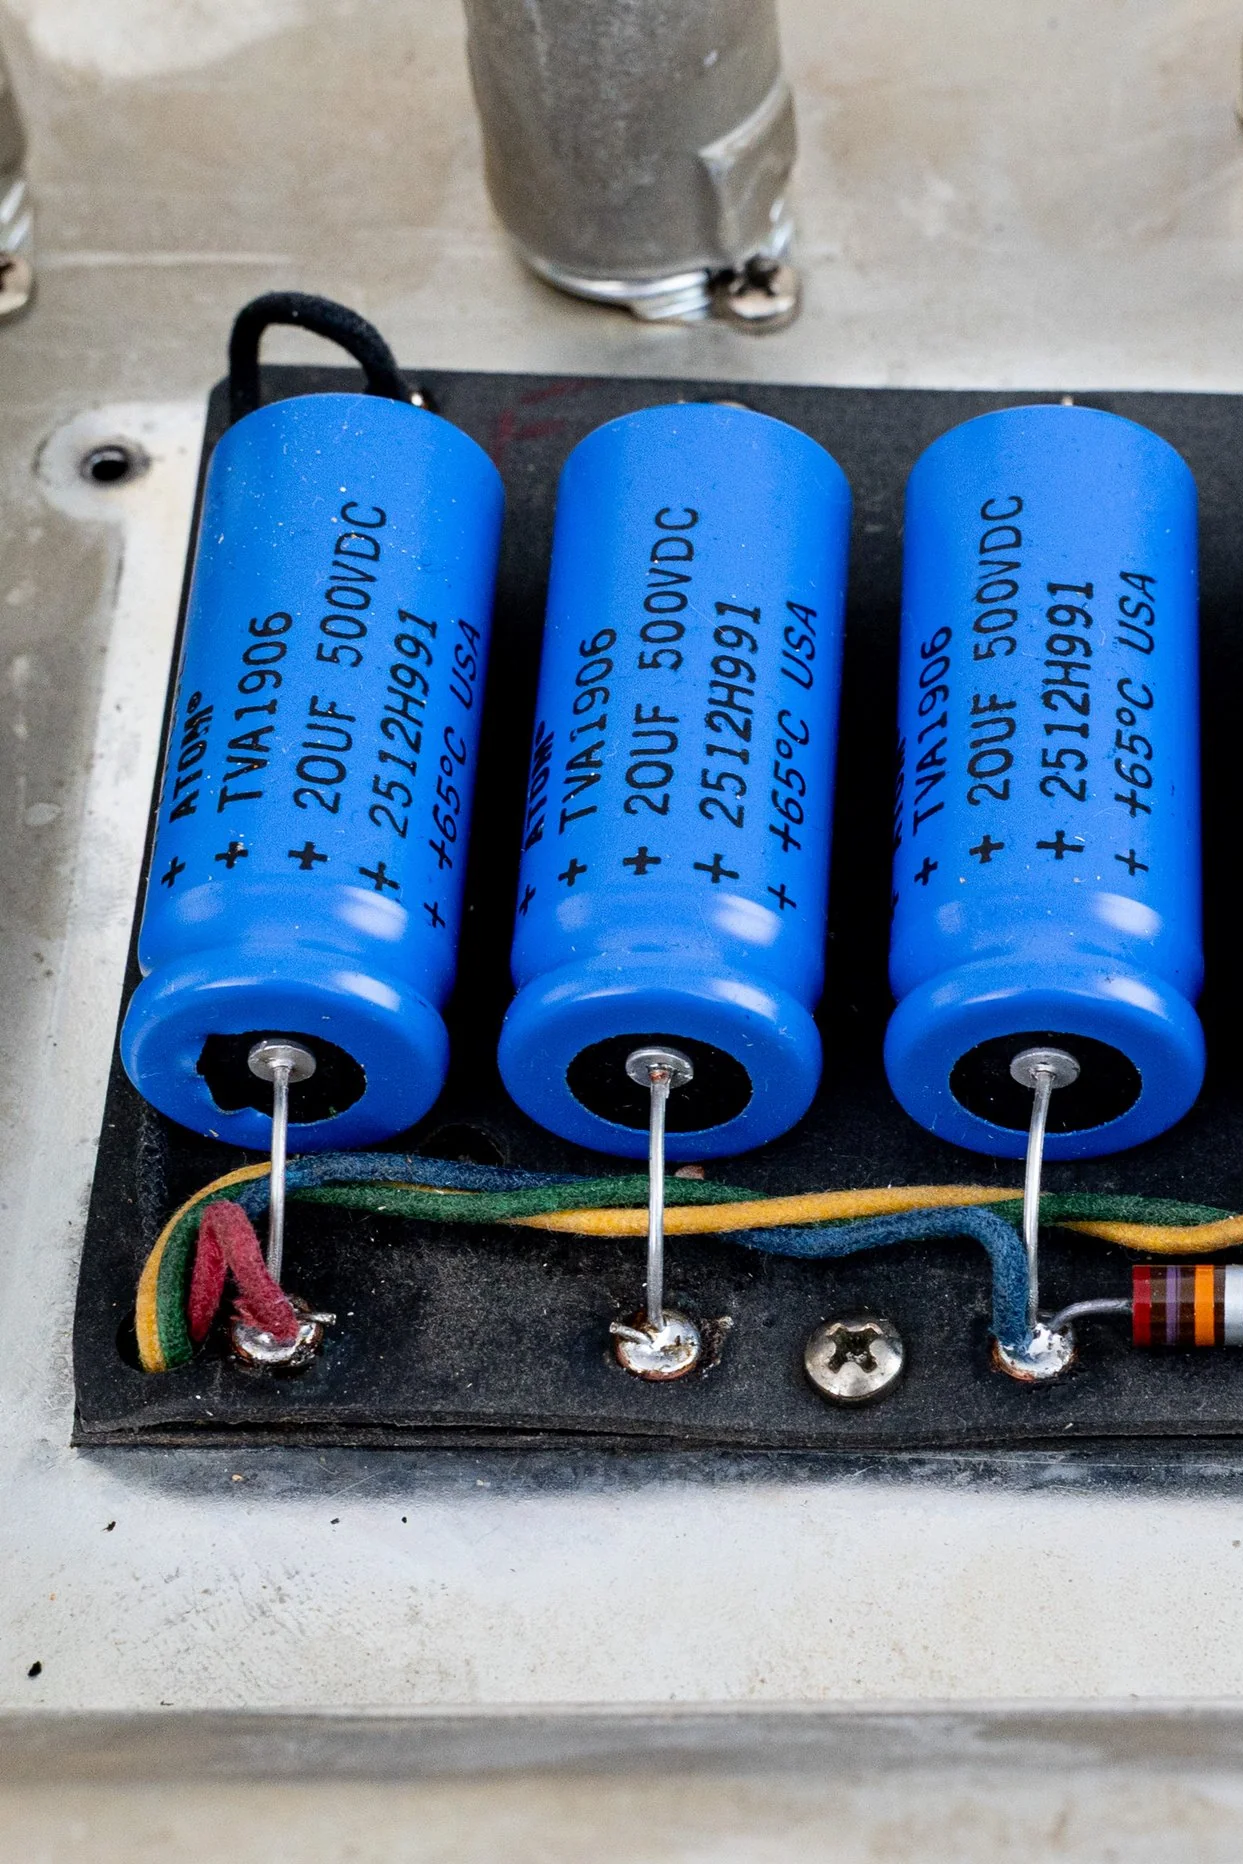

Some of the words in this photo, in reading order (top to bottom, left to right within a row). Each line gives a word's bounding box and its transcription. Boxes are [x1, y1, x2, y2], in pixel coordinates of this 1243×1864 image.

[317, 502, 387, 668] 500VDC
[638, 506, 699, 671] 500VDC
[781, 600, 818, 690] USA
[972, 495, 1024, 661] 500VDC
[1118, 570, 1158, 655] USA
[218, 611, 293, 813] TVA1906
[369, 609, 438, 838] 2512H991
[450, 619, 481, 710] USA
[559, 628, 618, 834] TVA1906
[698, 601, 761, 828] 2512H991
[912, 626, 953, 836] TVA1906
[1040, 581, 1094, 803] 2512H991
[296, 695, 356, 814] 20UF
[624, 703, 680, 816] 20UF
[967, 692, 1018, 806] 20UF
